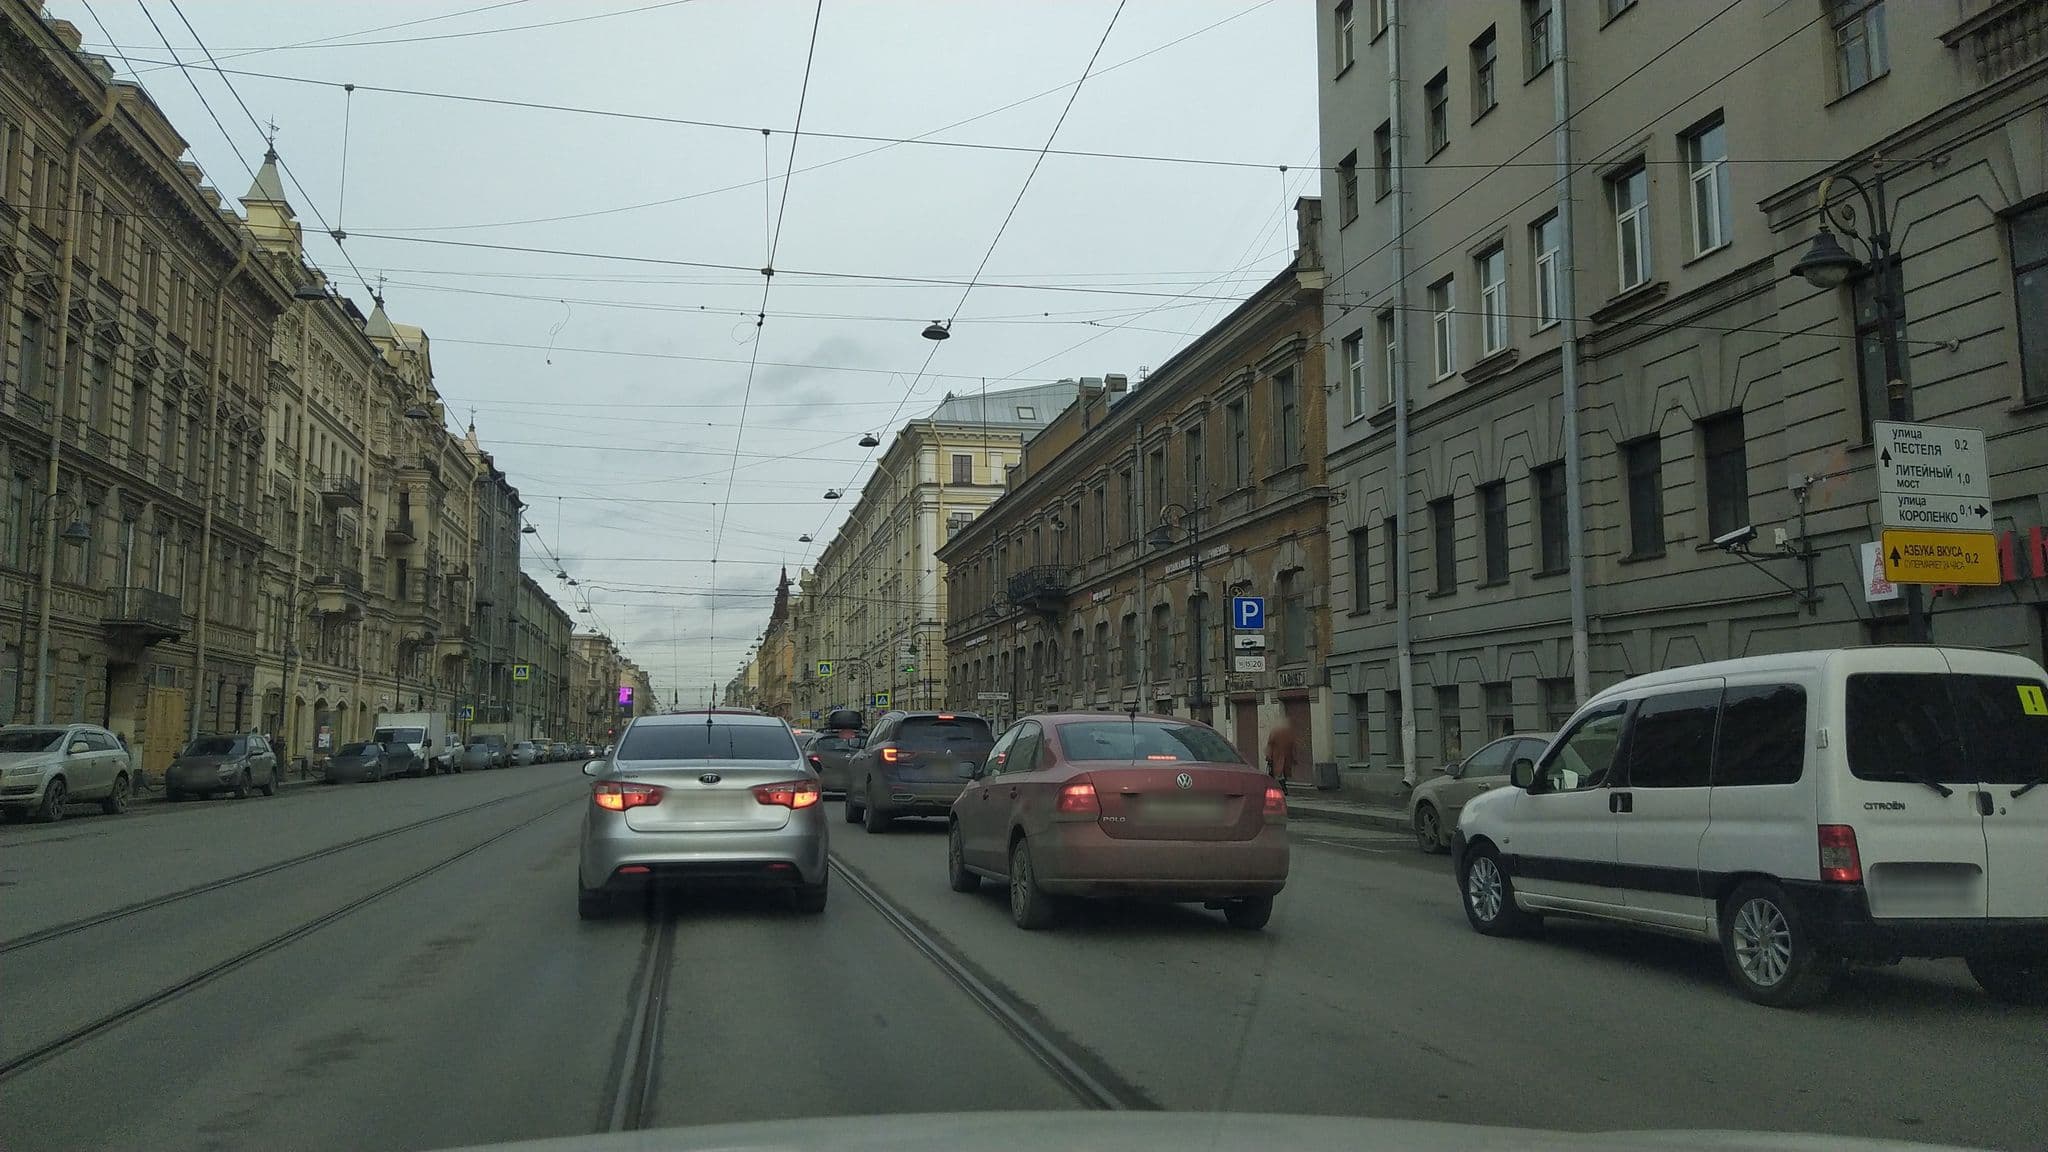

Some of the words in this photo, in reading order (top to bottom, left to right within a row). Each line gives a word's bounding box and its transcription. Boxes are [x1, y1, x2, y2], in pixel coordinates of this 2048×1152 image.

[1892, 428, 1922, 439] улица
[1894, 442, 1942, 456] ПЕСТЕЛЯ
[1896, 463, 1953, 479] ЛИТЕЙНЫЙ
[1897, 479, 1920, 489] мост
[1898, 495, 1927, 506] улица
[1899, 509, 1959, 523] КОРОЛЕНКО
[1904, 544, 1935, 557] АЗБУКА
[1936, 545, 1963, 557] ВКУСА
